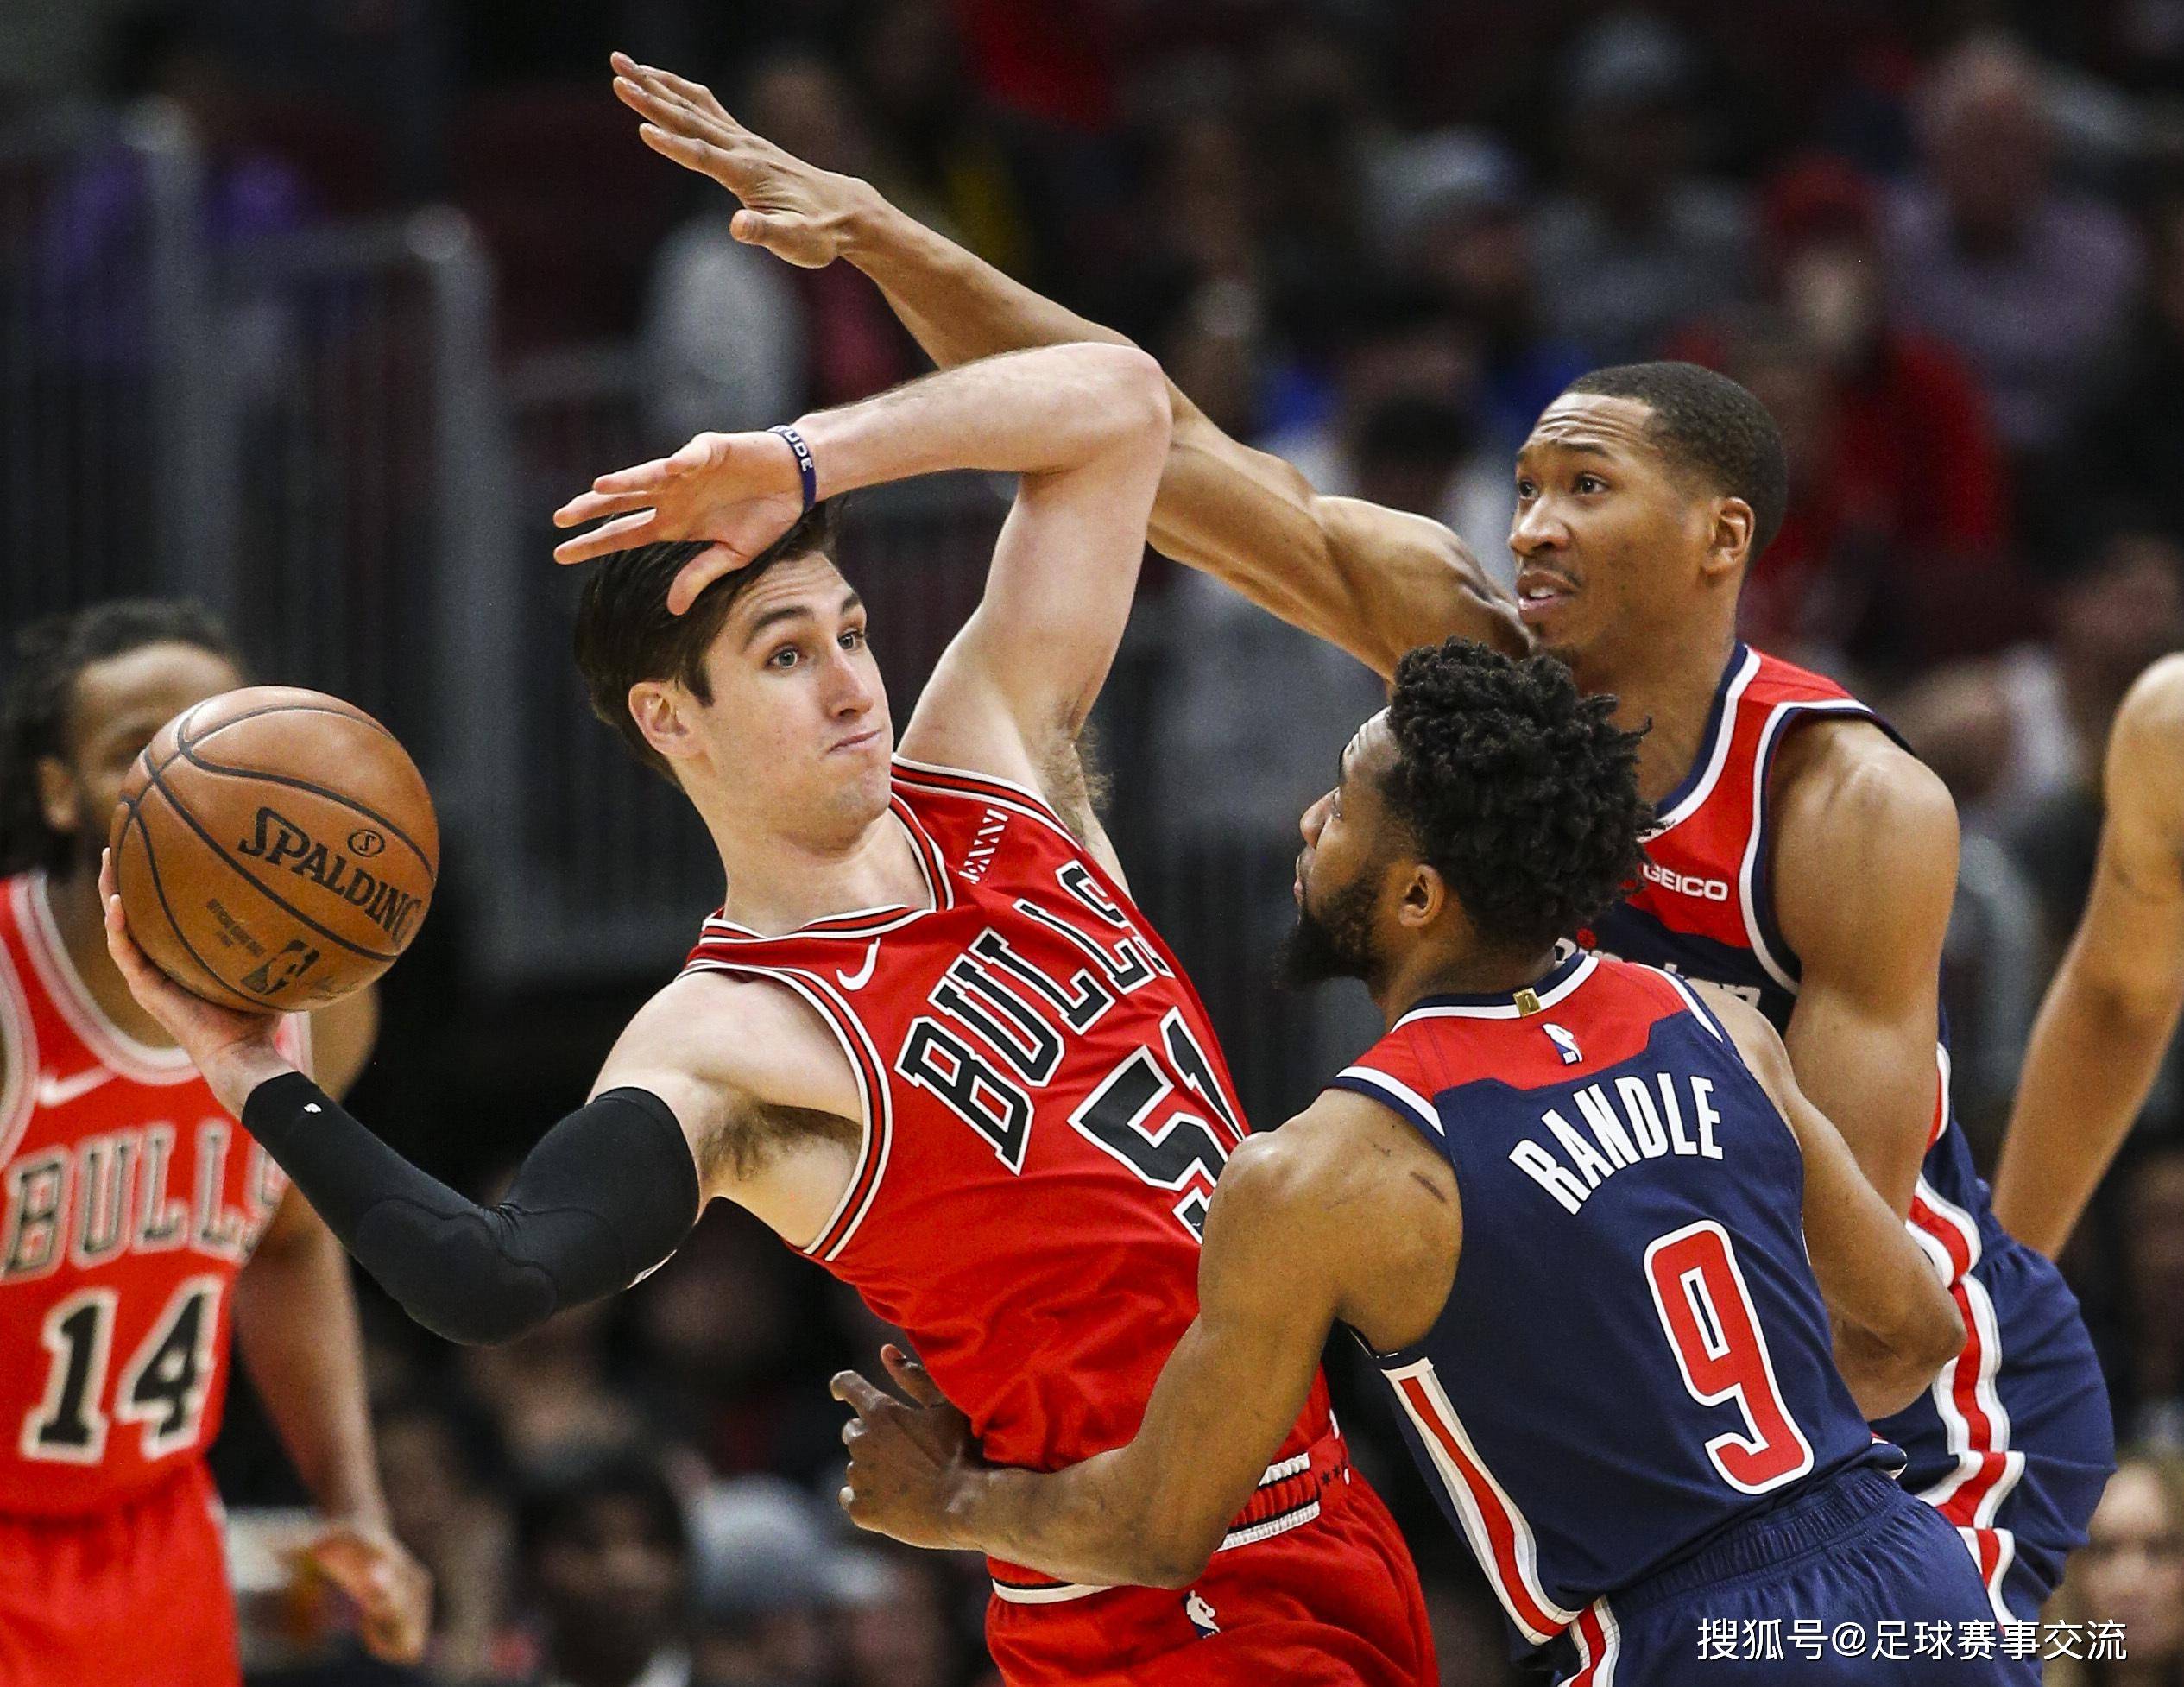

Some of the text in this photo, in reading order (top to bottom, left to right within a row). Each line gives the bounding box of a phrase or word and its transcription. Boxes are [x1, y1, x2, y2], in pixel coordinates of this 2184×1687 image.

[237, 806, 422, 943] SPALDING
[1643, 863, 1729, 902] GEICO
[1508, 1072, 1724, 1216] RANDLE
[19, 1273, 226, 1466] 14
[1644, 1219, 1814, 1494] 9
